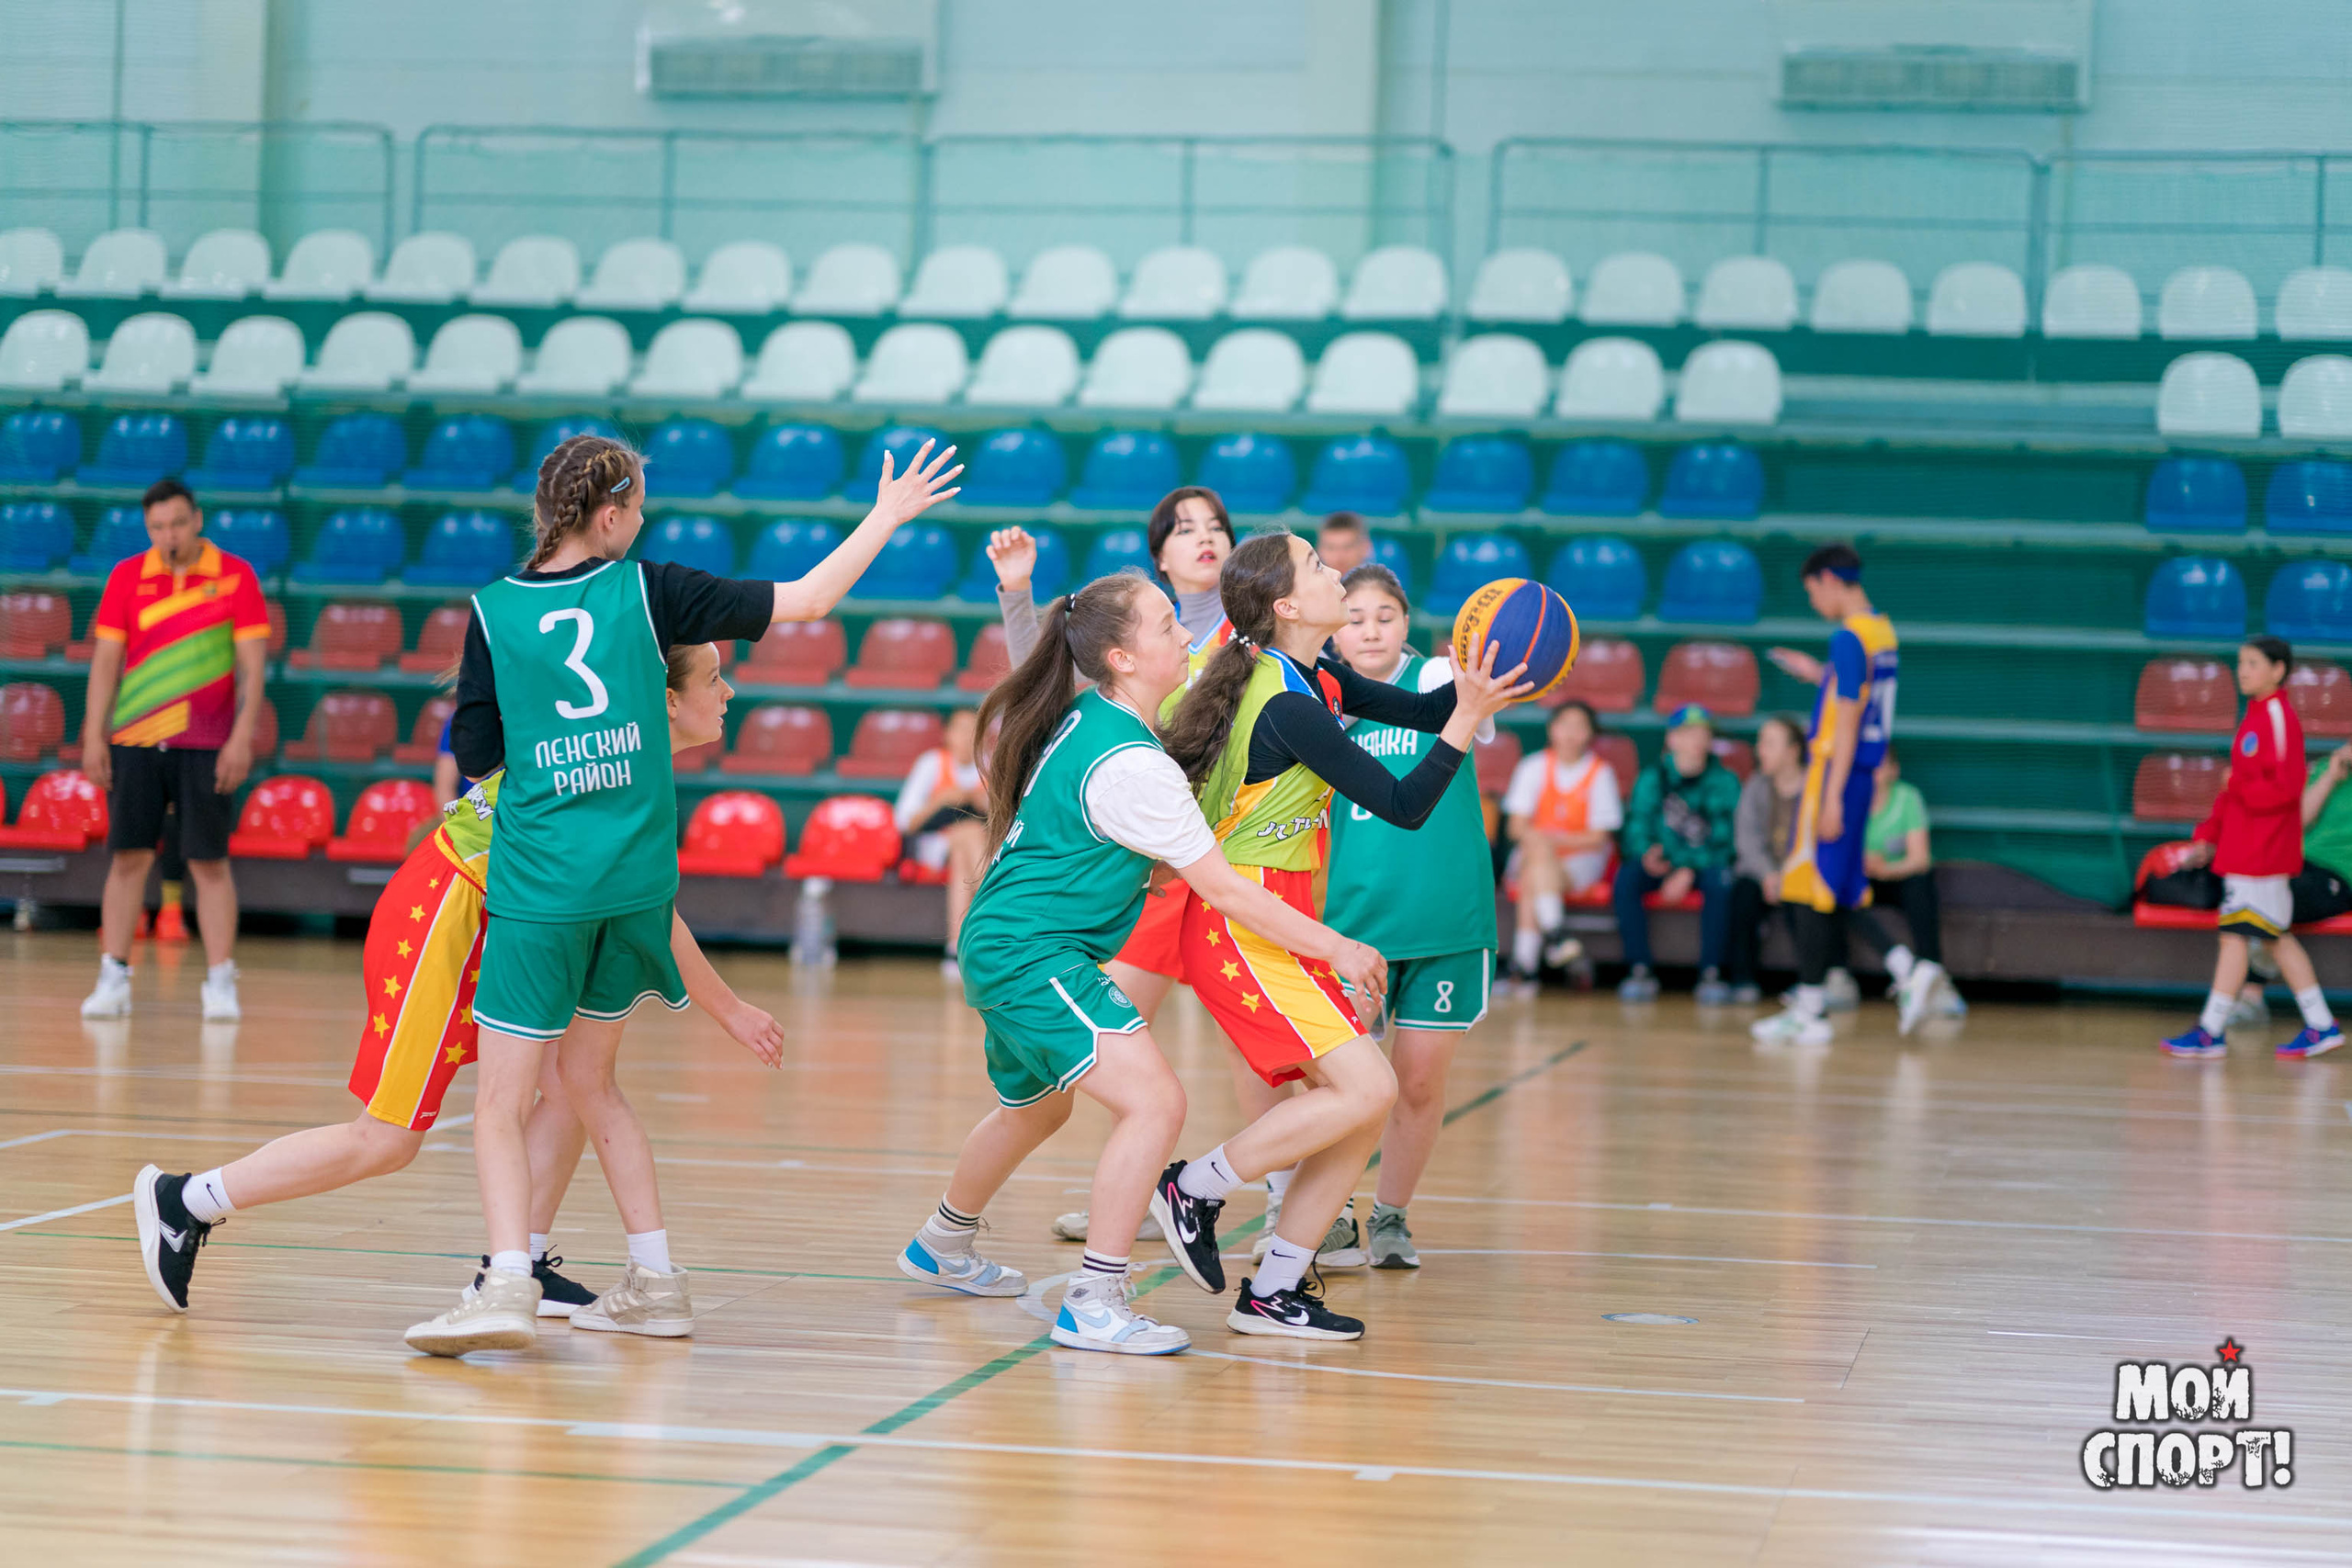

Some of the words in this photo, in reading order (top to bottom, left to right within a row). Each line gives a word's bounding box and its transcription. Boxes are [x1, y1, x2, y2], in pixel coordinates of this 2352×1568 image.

[538, 607, 609, 719] 3
[535, 721, 641, 769] ЛЕНСКИЙ
[553, 759, 632, 796] РАЙОН
[1433, 980, 1454, 1013] 8
